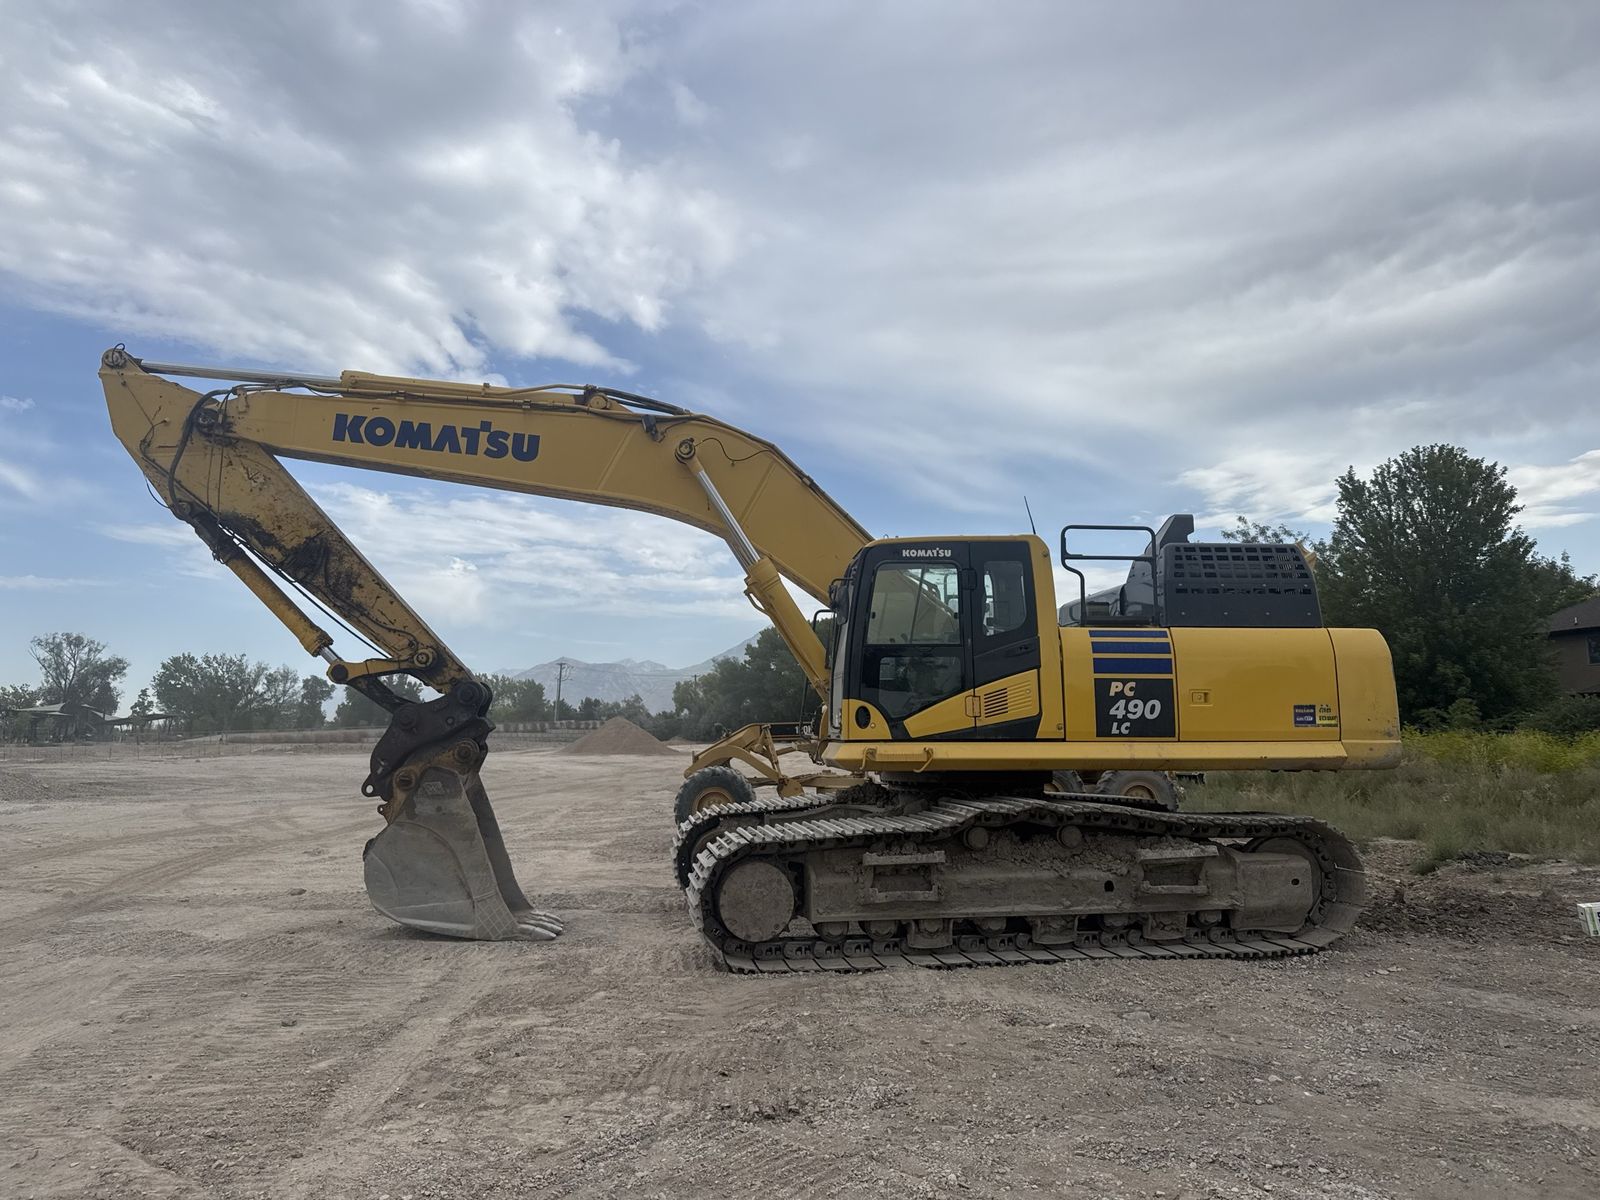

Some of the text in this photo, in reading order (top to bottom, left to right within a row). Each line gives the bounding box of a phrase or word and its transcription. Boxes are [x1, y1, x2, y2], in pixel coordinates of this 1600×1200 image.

[332, 413, 541, 462] KOMATSU
[902, 547, 952, 557] KOMATSU
[1109, 681, 1136, 697] PC
[1109, 699, 1161, 720] 490
[1111, 721, 1131, 735] LC
